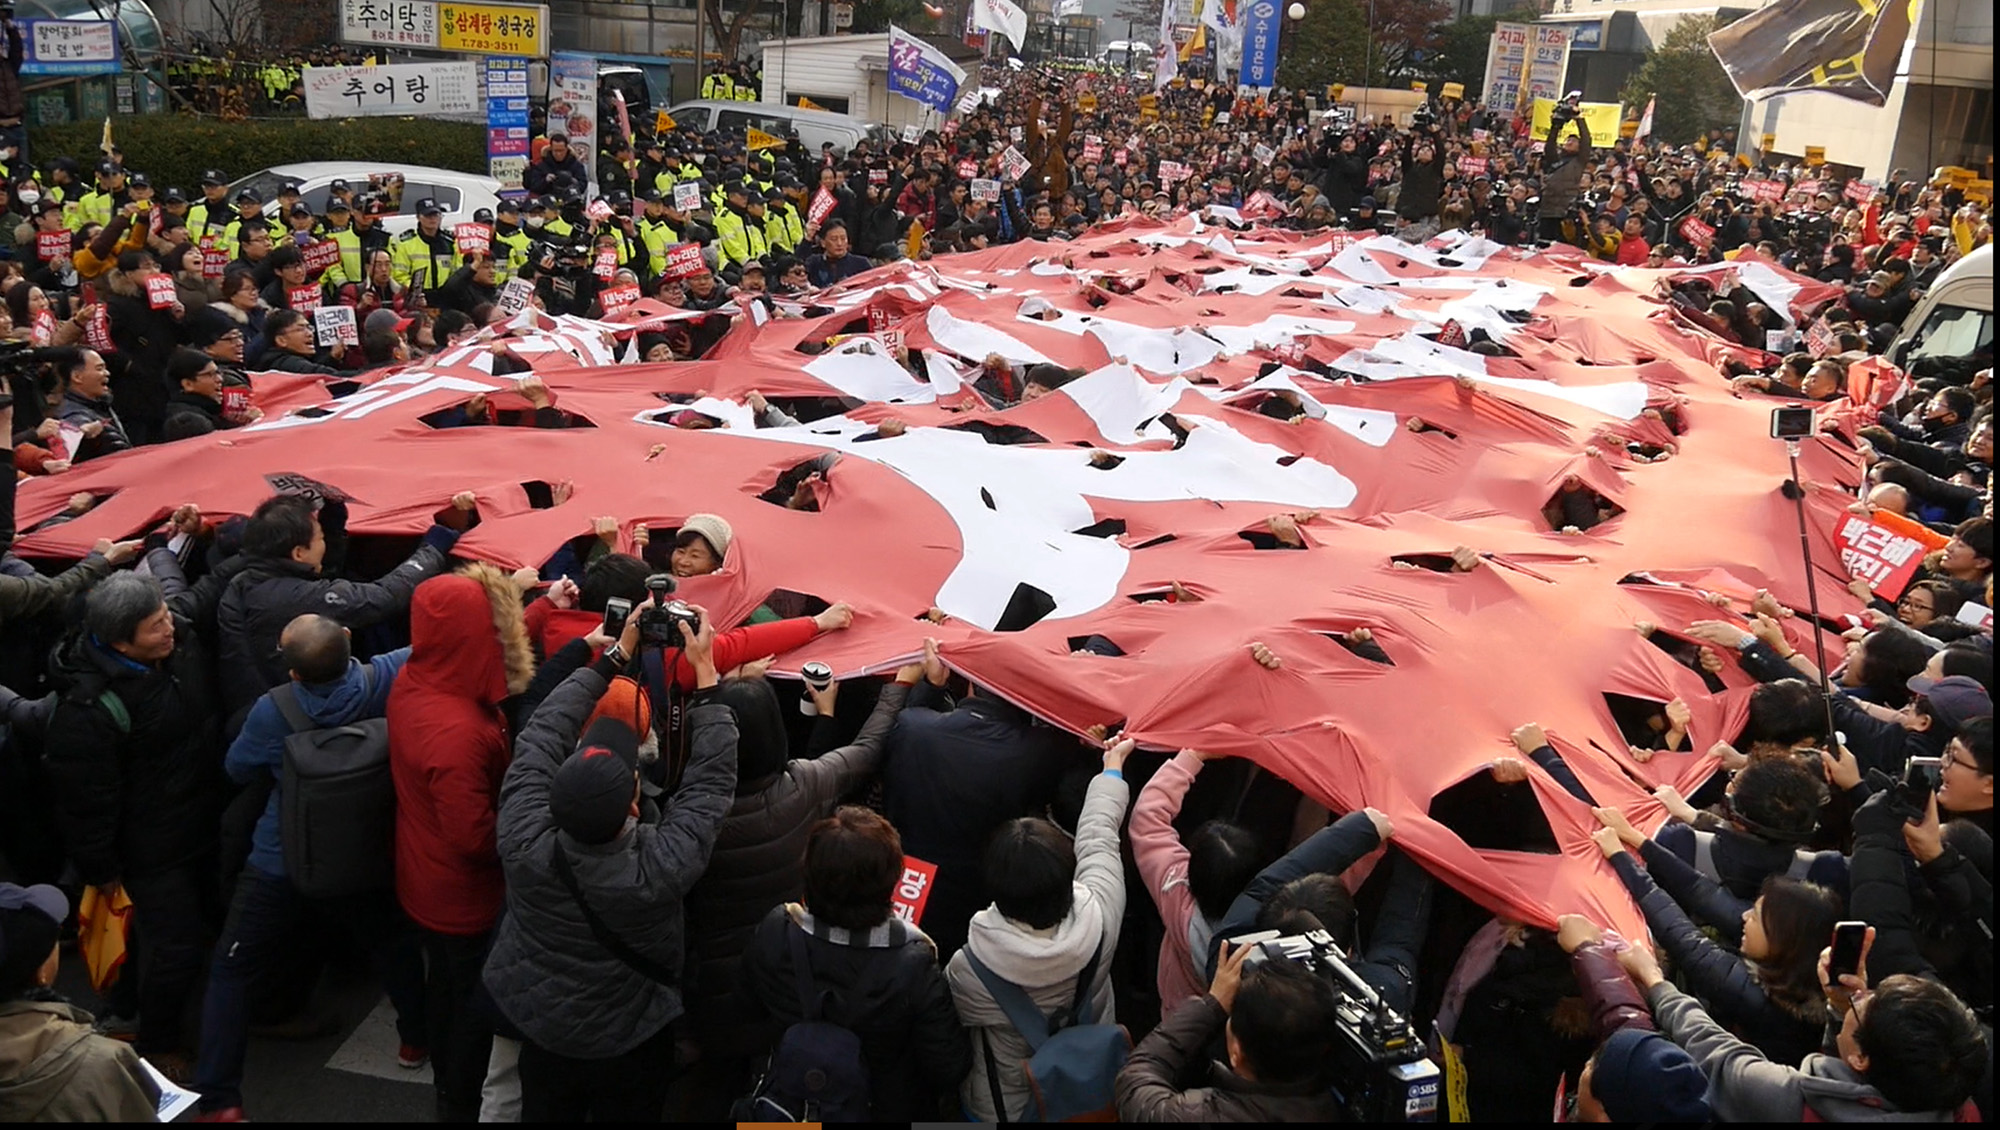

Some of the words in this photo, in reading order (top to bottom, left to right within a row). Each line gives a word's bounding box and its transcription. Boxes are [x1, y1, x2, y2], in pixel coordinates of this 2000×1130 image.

[358, 0, 418, 31] 추어탕
[1252, 20, 1268, 80] 수협은행
[1499, 31, 1526, 44] 치과
[1538, 47, 1562, 61] 안경
[342, 75, 429, 108] 추어탕
[1840, 517, 1925, 568] 박근혜
[1420, 1083, 1437, 1095] SBS
